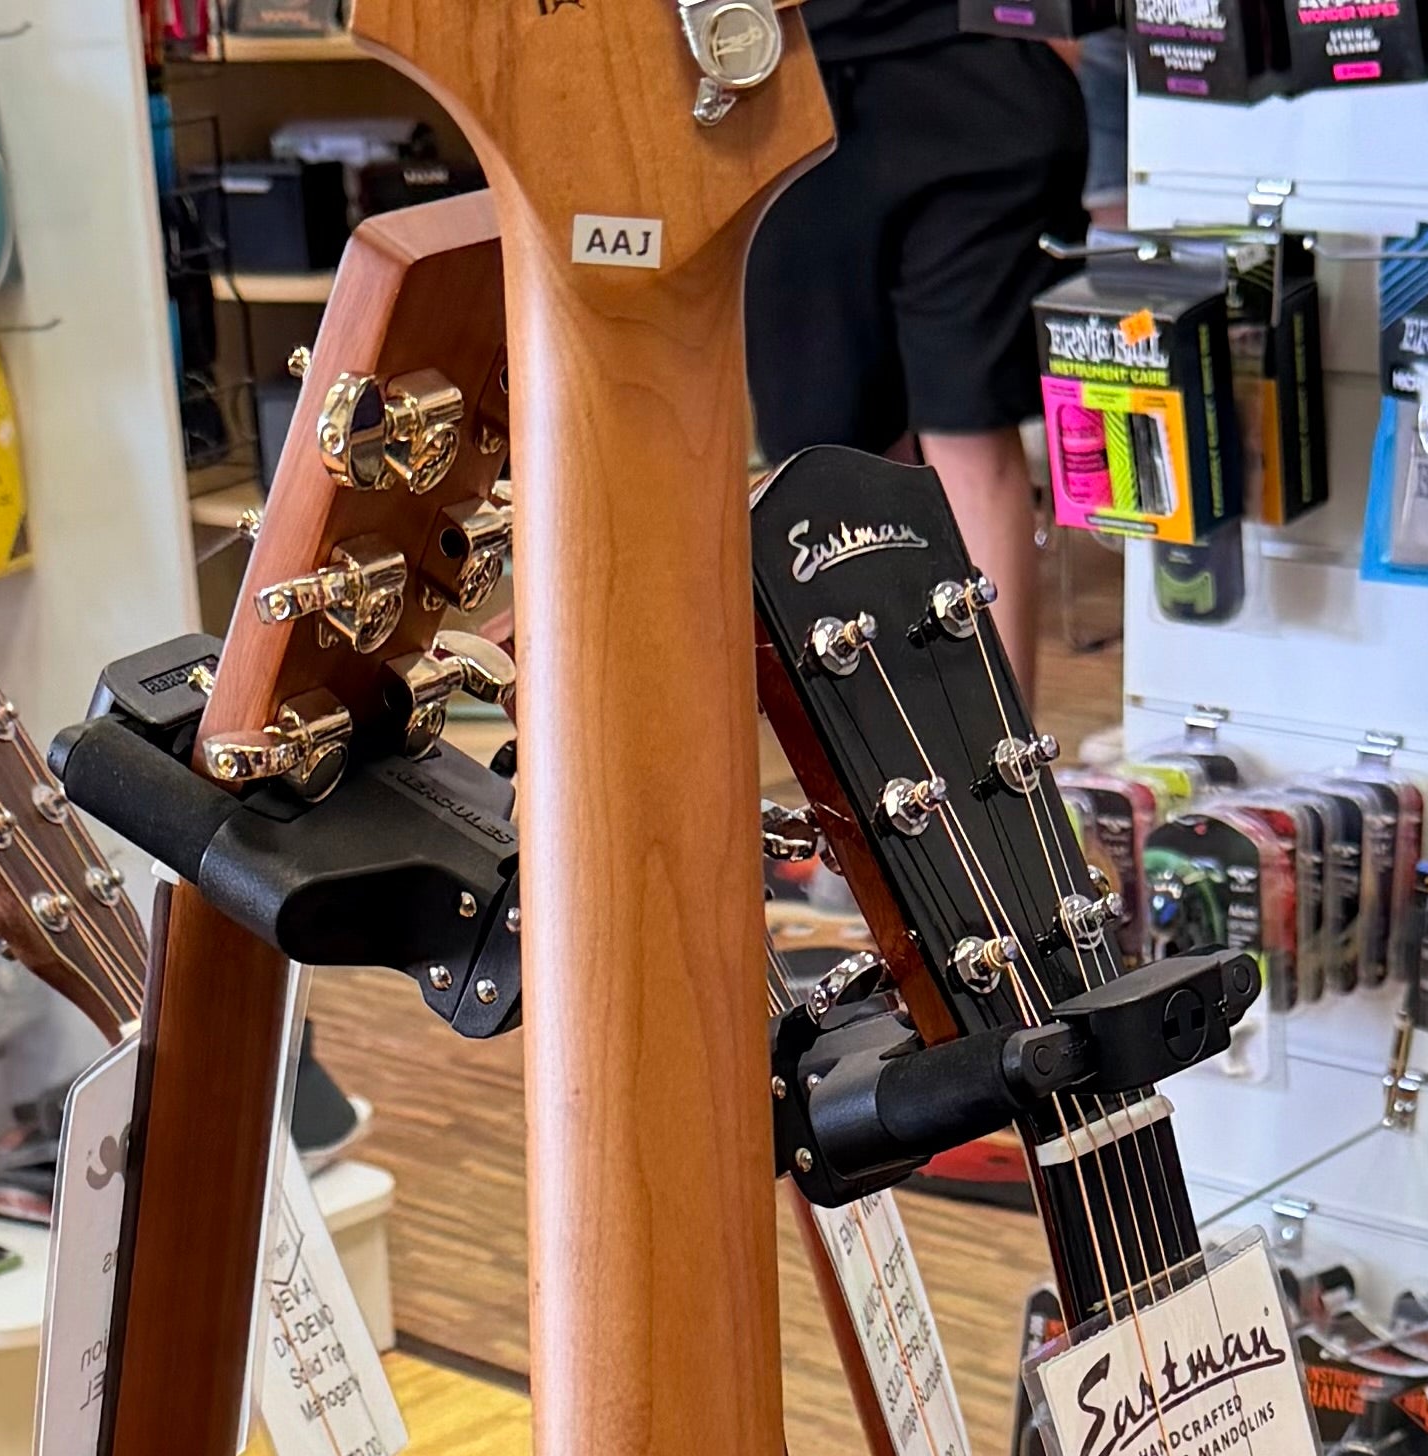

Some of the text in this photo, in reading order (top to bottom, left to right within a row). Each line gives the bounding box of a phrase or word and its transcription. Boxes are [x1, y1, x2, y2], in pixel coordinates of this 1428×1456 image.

[586, 228, 652, 256] AAJ
[1045, 314, 1109, 363] ERNIE
[1049, 358, 1130, 383] INSTRUMENT
[788, 519, 929, 583] Eastman
[386, 769, 515, 845] HERCULES
[322, 1343, 346, 1364] Top
[300, 1376, 363, 1423] Mahogany
